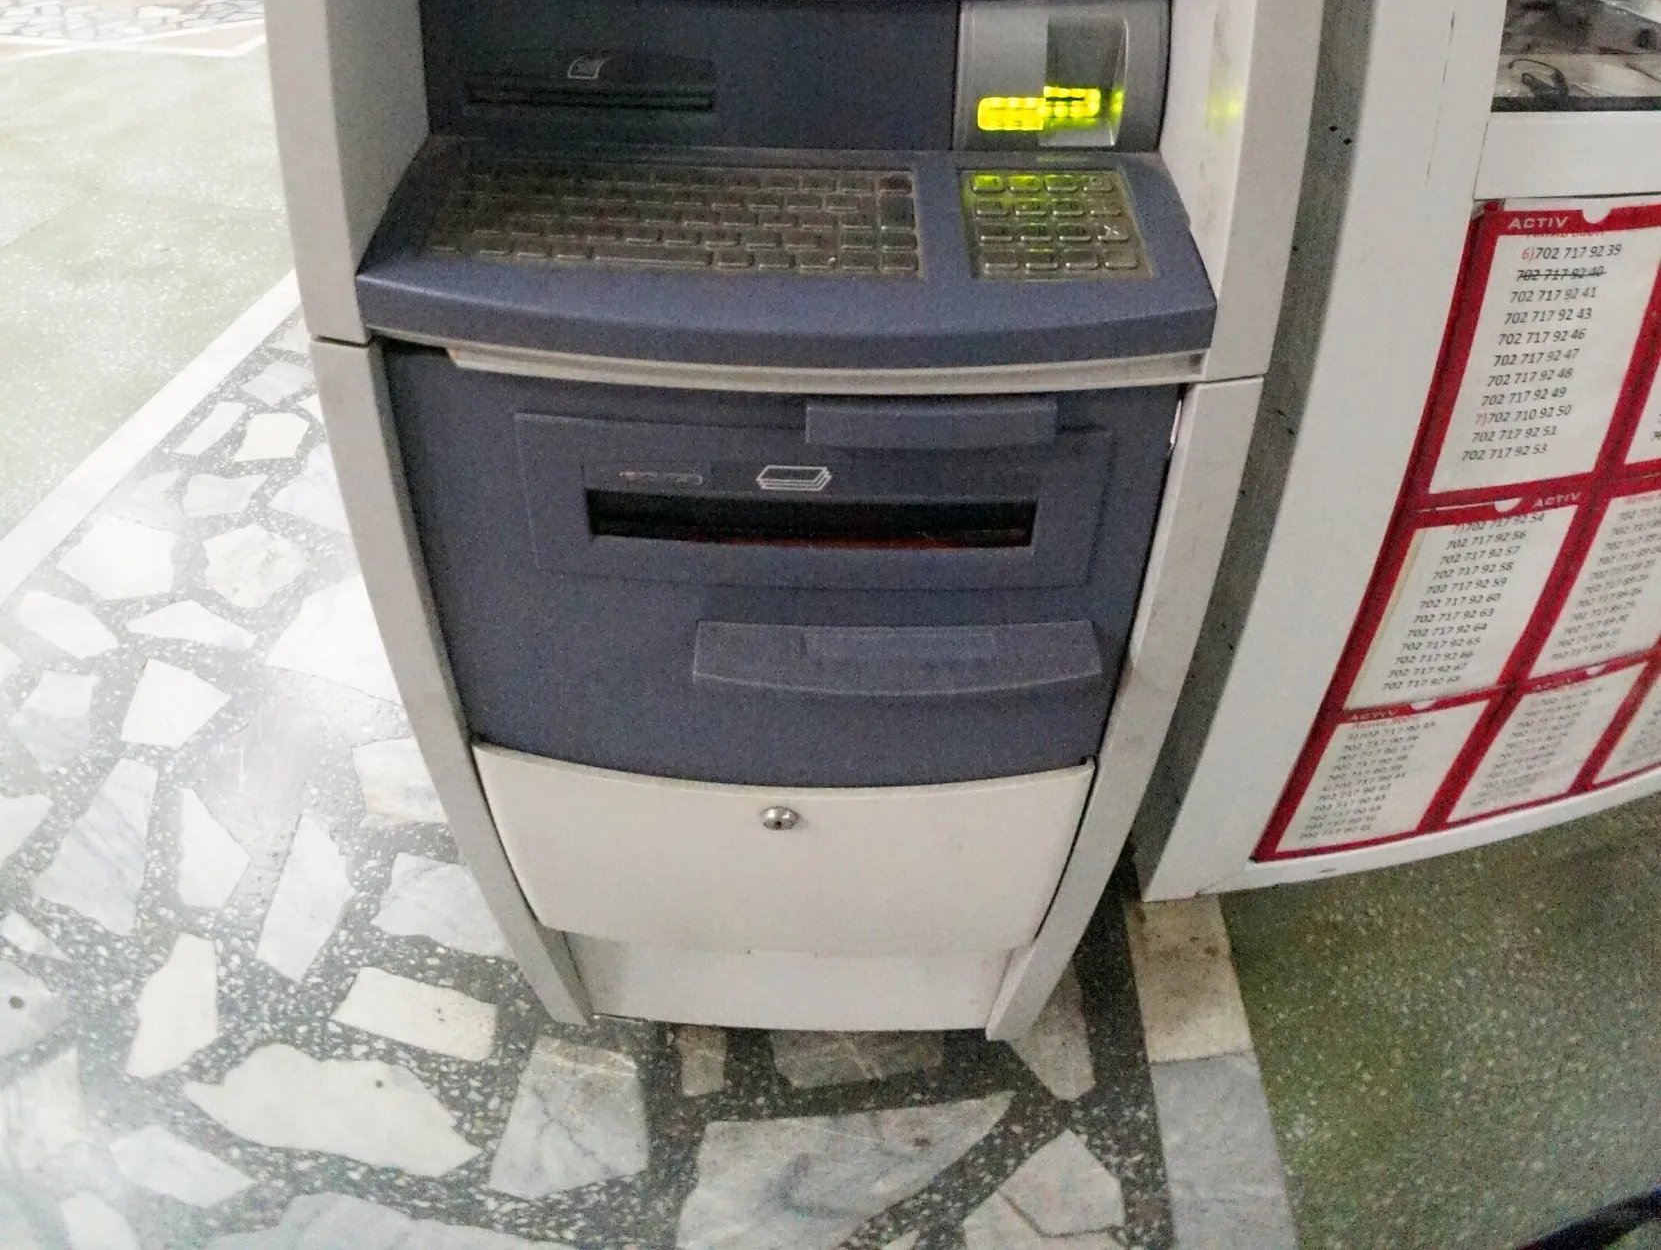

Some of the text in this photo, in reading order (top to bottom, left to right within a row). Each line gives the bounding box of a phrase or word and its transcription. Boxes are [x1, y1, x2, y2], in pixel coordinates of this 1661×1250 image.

[1507, 216, 1569, 230] ACTIV
[1564, 246, 1586, 260] 717
[1589, 245, 1605, 258] 92
[1607, 244, 1622, 256] 39
[1510, 287, 1598, 303] 702 717 92 41
[1505, 308, 1592, 325] 702 717 92 43
[1498, 328, 1586, 346] 702 717 92 46
[1493, 348, 1580, 367] 702 717 92 47
[1487, 368, 1573, 387] 702 717 92 48
[1481, 387, 1567, 407] 702 717 92 49
[1514, 410, 1536, 422] 710
[1539, 408, 1554, 420] 92
[1556, 405, 1572, 416] 50
[1472, 425, 1557, 443] 702 717 92 51
[1461, 443, 1548, 462] 702 717 92 53
[1472, 535, 1494, 546] 717
[1495, 533, 1510, 543] 92
[1464, 551, 1486, 562] 717
[1457, 567, 1479, 577] 717
[1481, 564, 1496, 574] 92
[1450, 581, 1473, 592] 717
